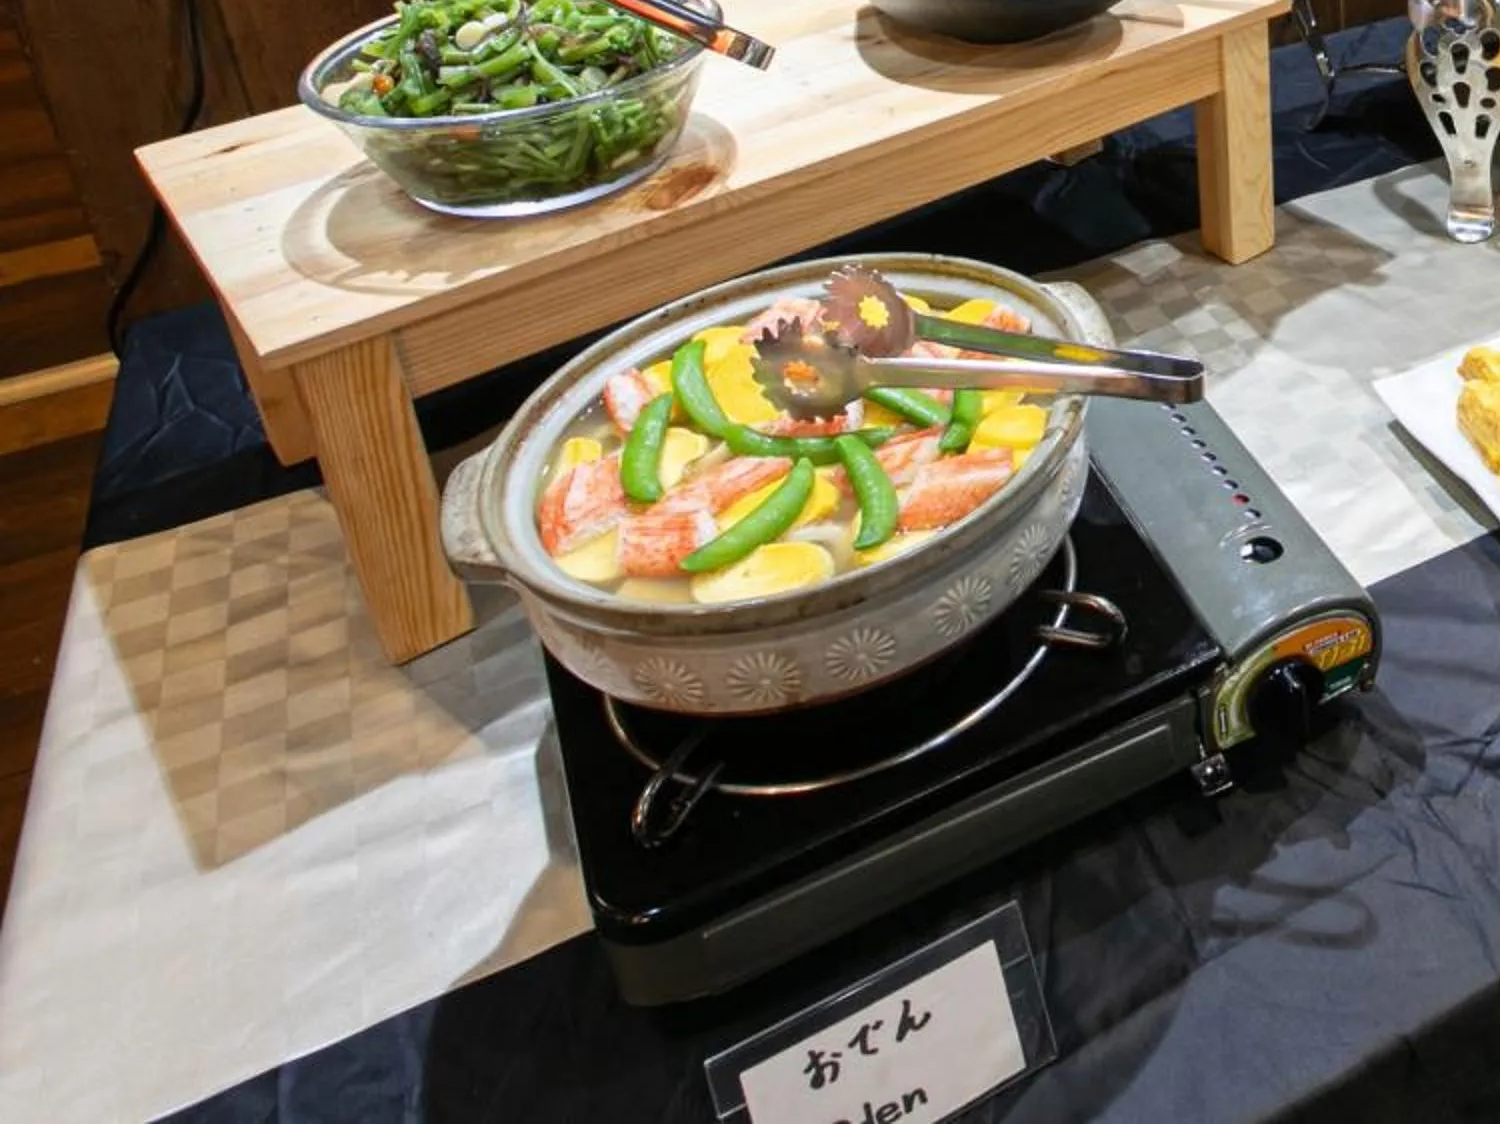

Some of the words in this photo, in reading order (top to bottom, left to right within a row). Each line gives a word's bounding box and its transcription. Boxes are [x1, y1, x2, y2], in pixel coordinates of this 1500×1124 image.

[803, 999, 932, 1089] おでん
[832, 1087, 928, 1124] den
